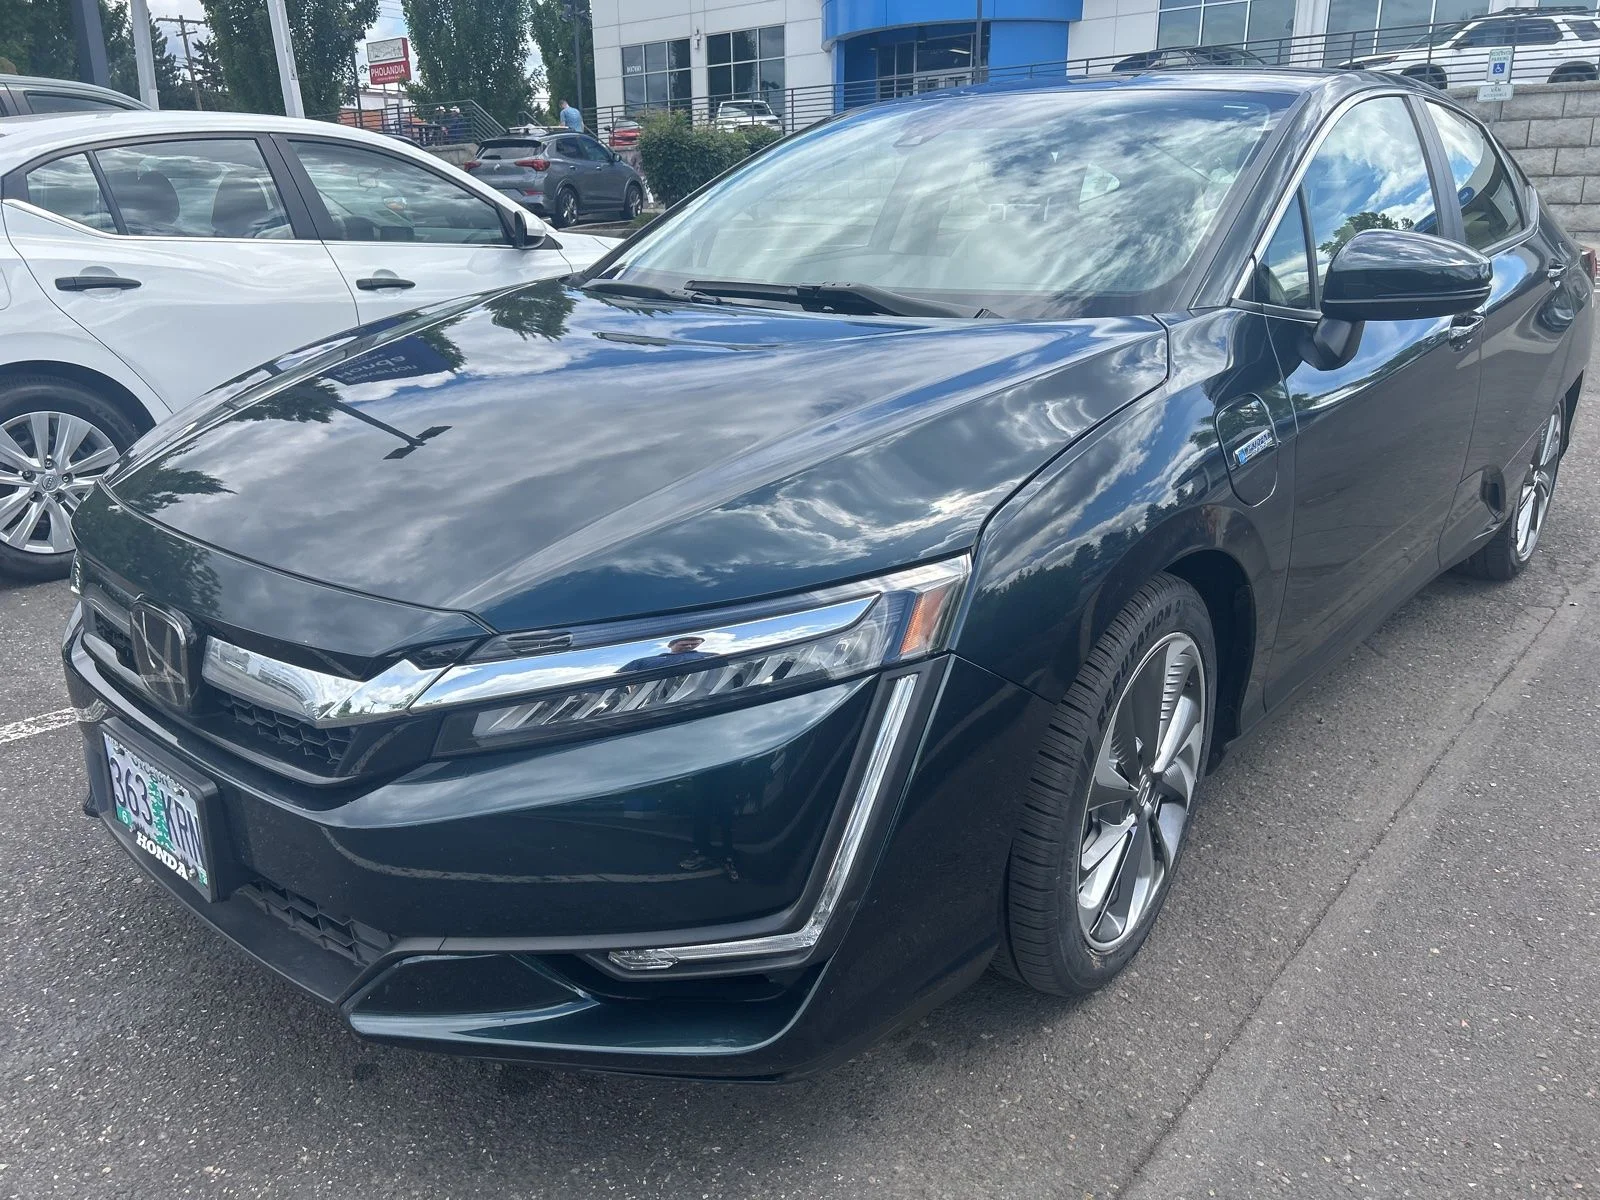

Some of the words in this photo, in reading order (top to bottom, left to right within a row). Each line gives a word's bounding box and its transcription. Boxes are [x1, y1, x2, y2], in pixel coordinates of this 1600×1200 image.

[371, 65, 405, 77] PHOLANDIA
[1097, 603, 1172, 727] REPUTATION
[110, 757, 153, 825] 363
[160, 789, 200, 864] KRN
[135, 831, 189, 881] HONDA
